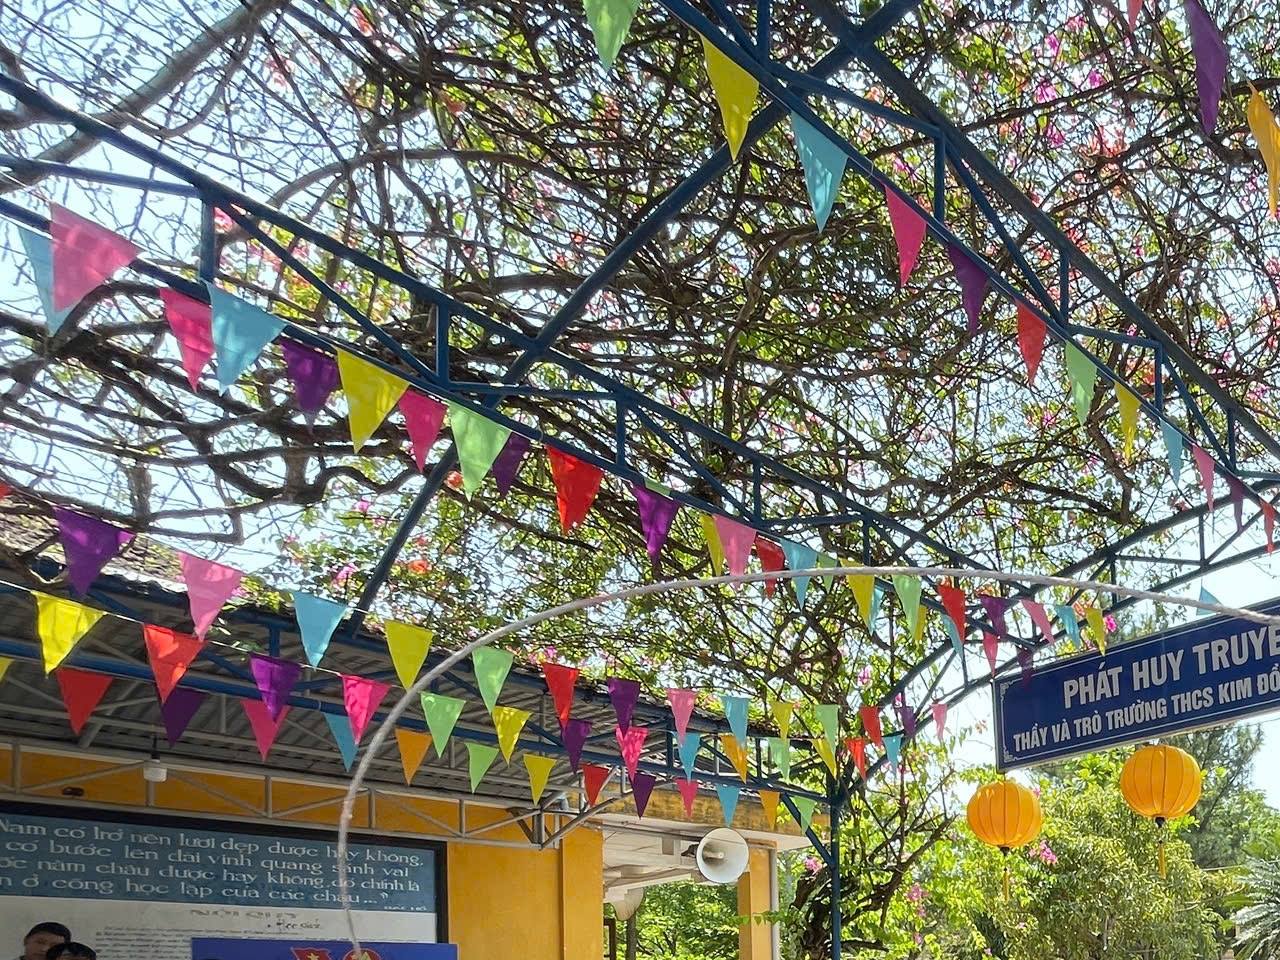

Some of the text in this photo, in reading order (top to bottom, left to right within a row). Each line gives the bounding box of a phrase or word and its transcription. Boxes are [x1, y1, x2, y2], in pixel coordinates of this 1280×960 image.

[1063, 661, 1123, 709] PHÁT
[1132, 649, 1184, 691] HUY
[1013, 722, 1048, 752] THẦY
[1052, 719, 1071, 743] VÀ
[1074, 710, 1101, 738] TRÒ
[1105, 699, 1168, 730] TRƯỜNG
[1171, 686, 1214, 715] THCS
[1218, 677, 1252, 705] KIM
